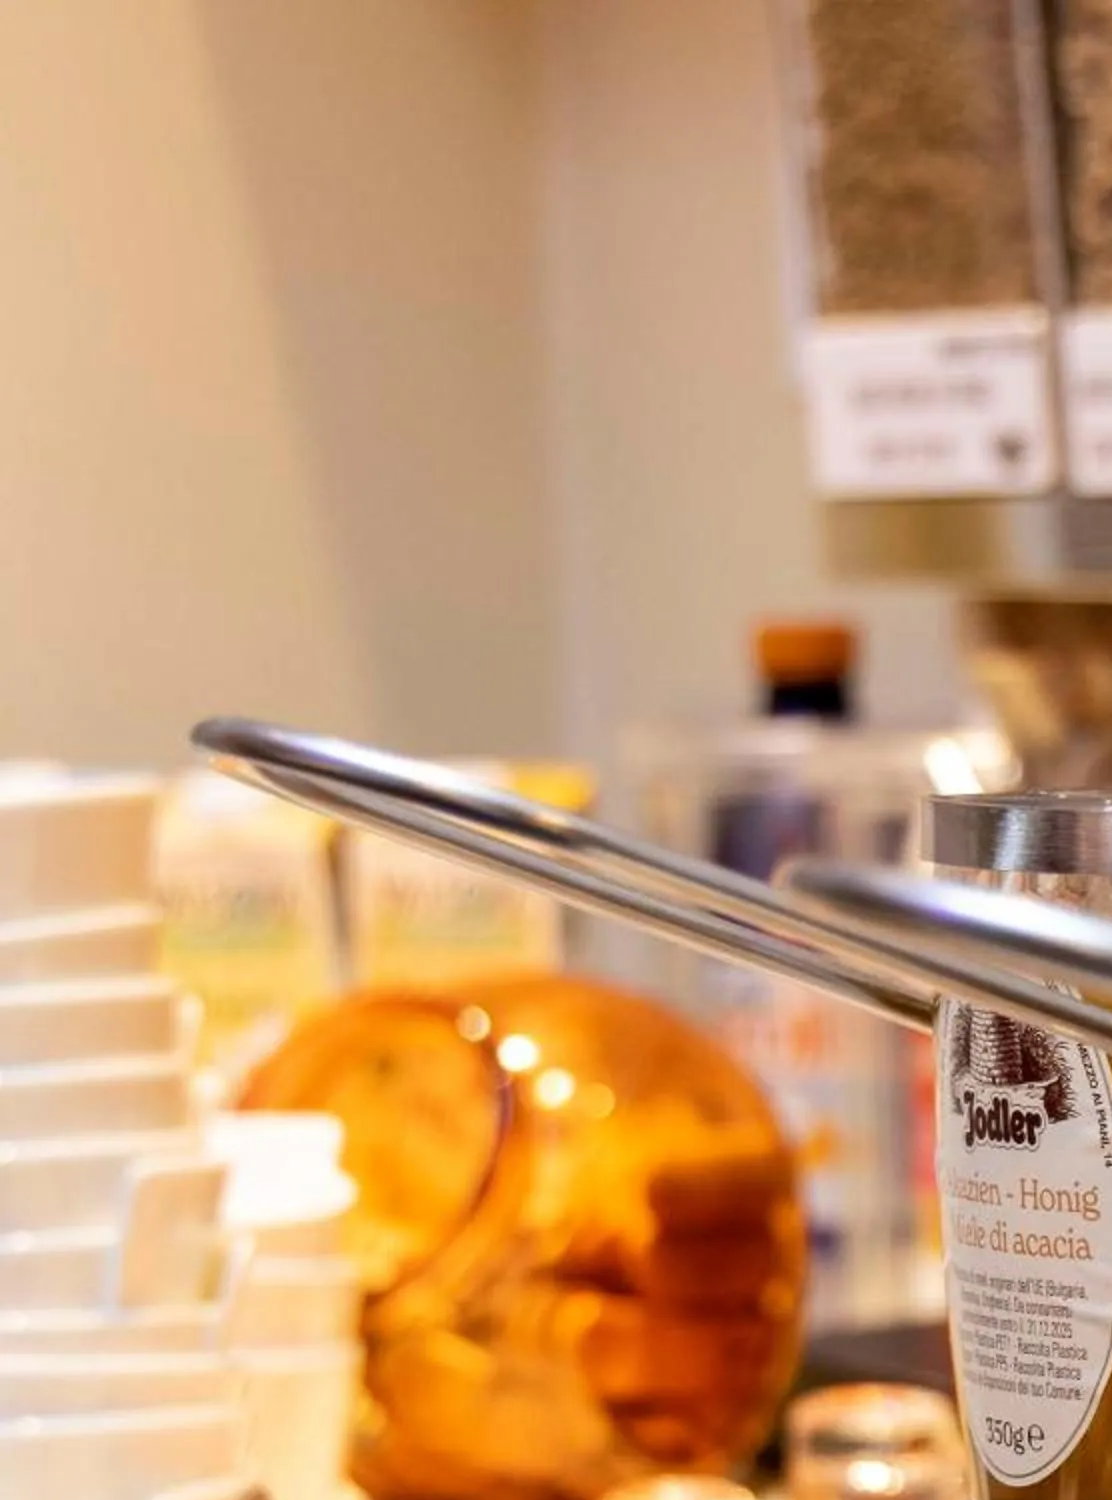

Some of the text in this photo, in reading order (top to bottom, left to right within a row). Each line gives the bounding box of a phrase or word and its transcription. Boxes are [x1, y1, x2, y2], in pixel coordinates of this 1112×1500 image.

[964, 1091, 1042, 1147] Jodler
[950, 1167, 1002, 1206] kazien
[1020, 1177, 1101, 1221] Honig
[990, 1220, 1009, 1253] di
[1013, 1228, 1095, 1260] acacia
